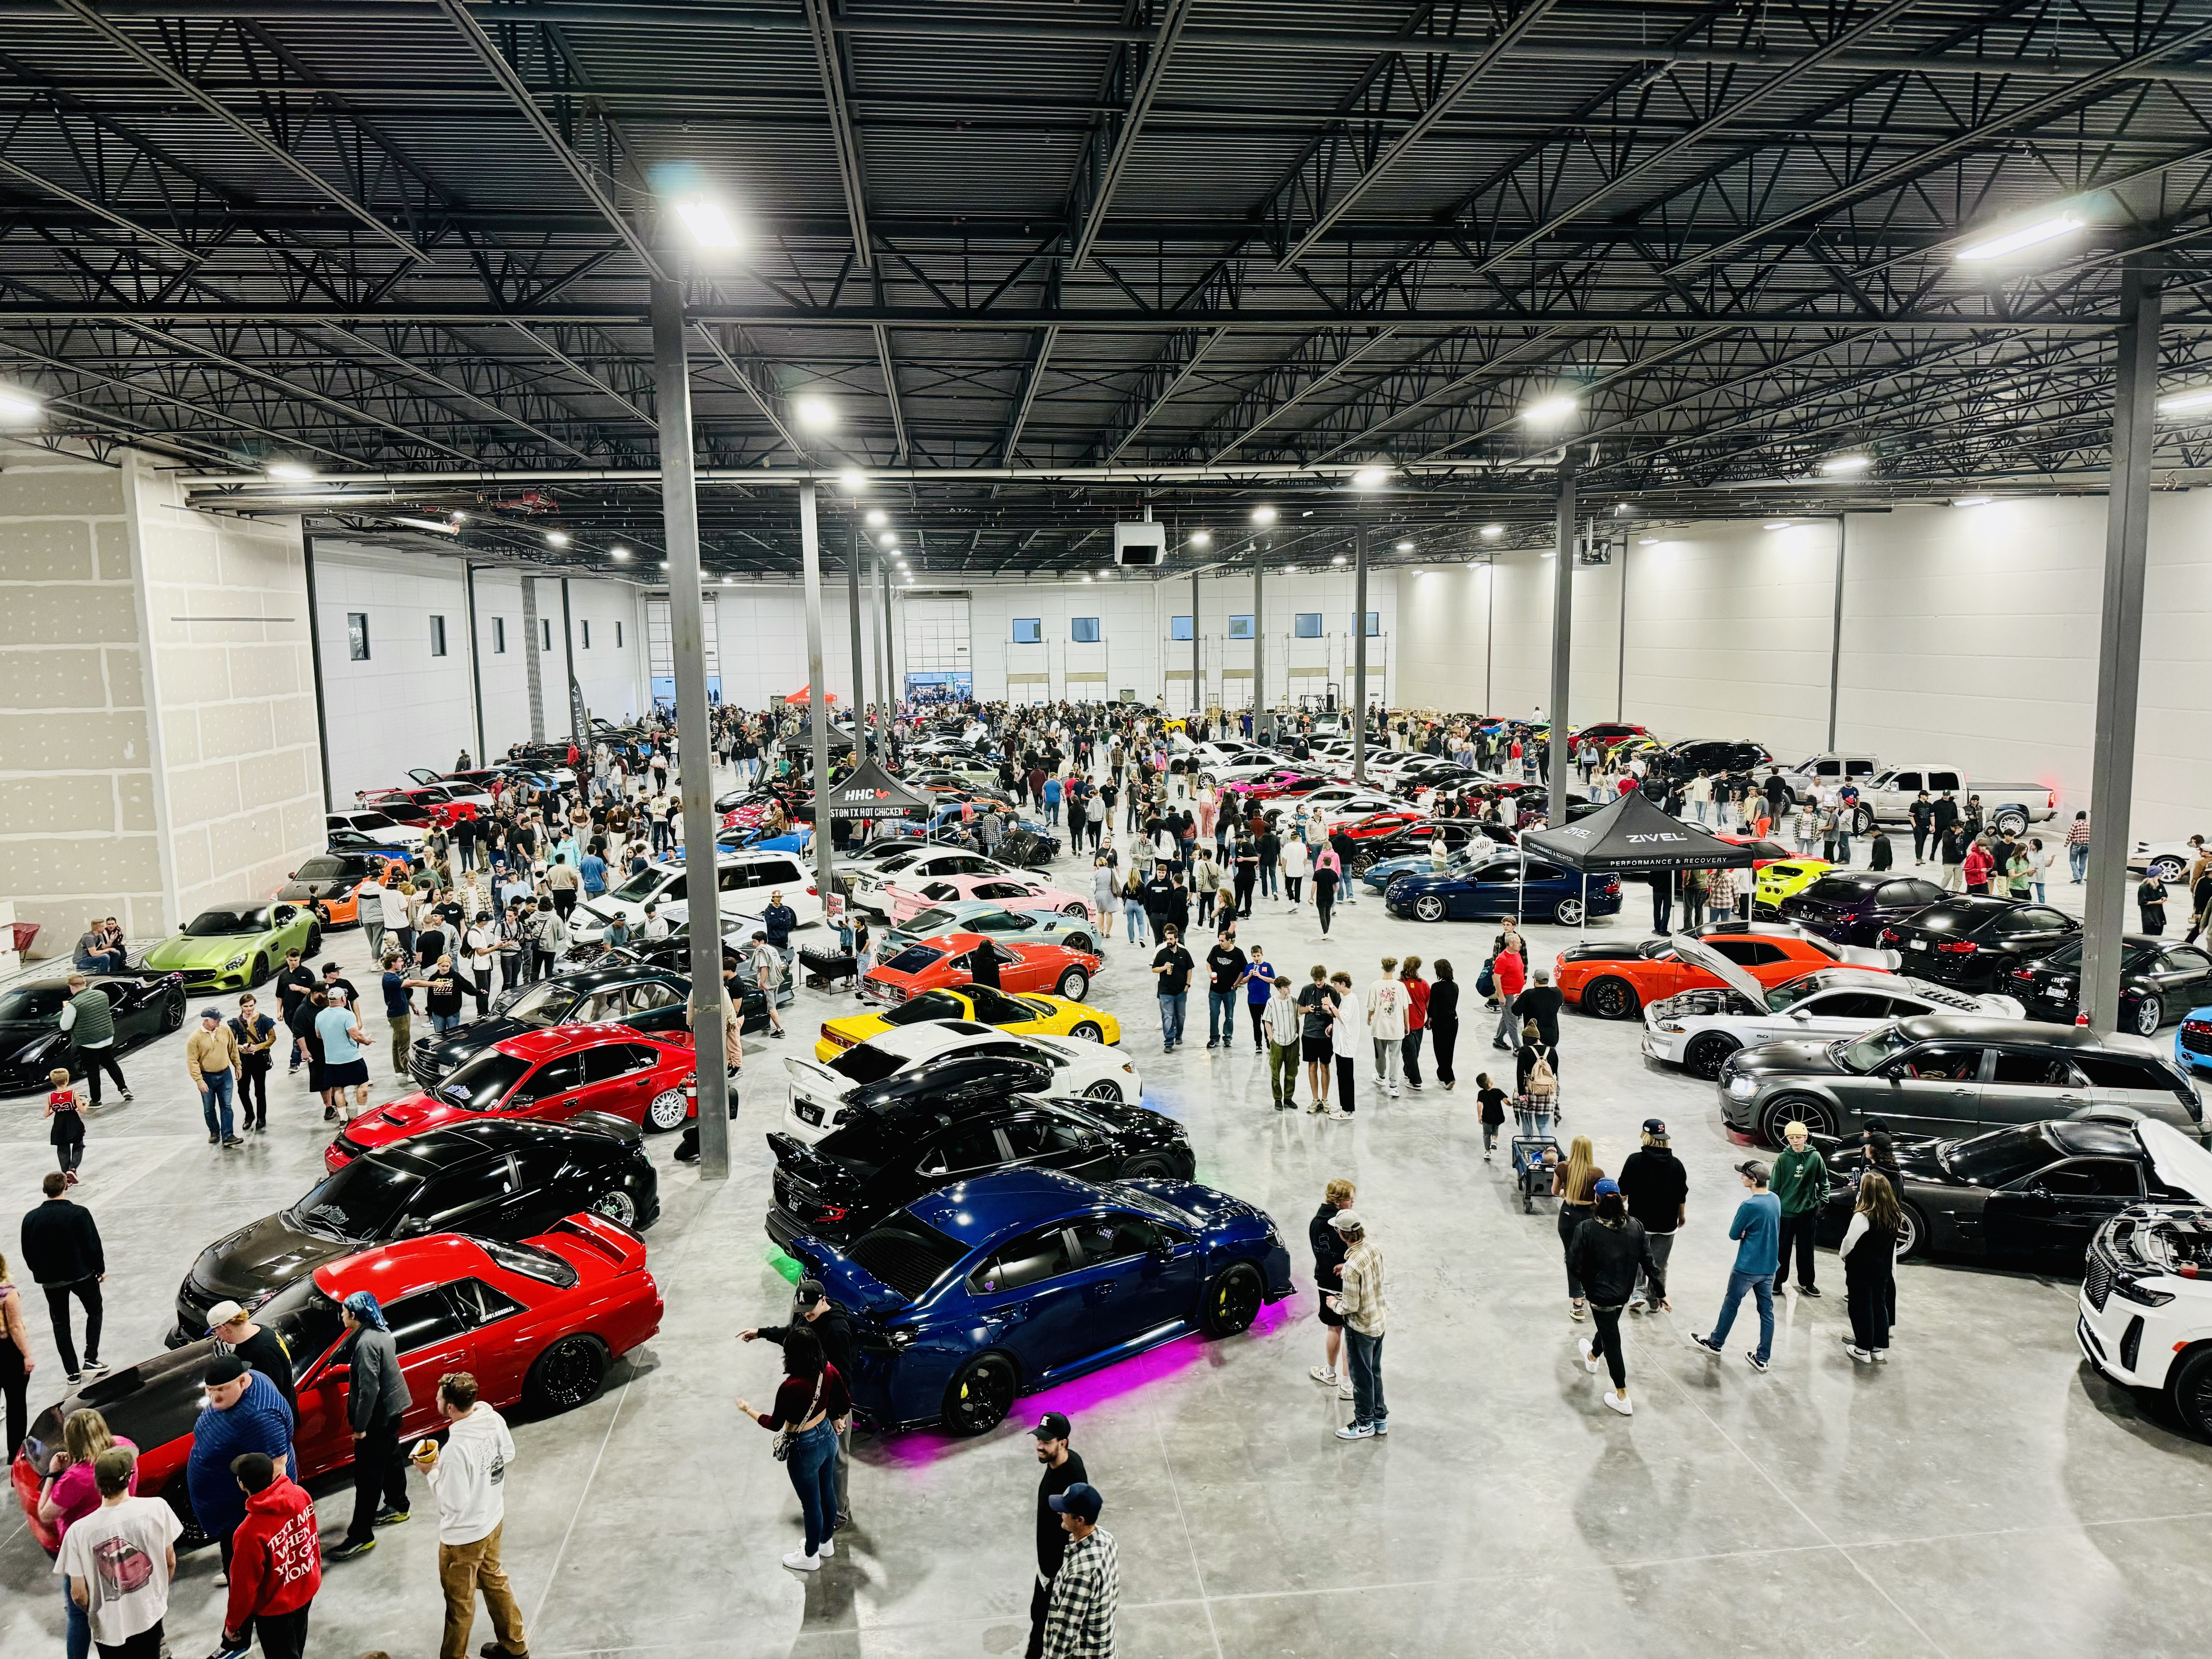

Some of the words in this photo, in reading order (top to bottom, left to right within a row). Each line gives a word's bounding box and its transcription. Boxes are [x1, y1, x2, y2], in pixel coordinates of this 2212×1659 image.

[845, 788, 874, 801] HHC
[830, 808, 849, 817] STON
[850, 808, 859, 817] TX
[860, 807, 874, 817] HOT
[874, 807, 903, 817] CHICKEN
[1626, 833, 1688, 843] ZIVEL
[1530, 842, 1552, 855] PERFORMANCE
[1556, 852, 1573, 863] RECOVERY
[52, 1102, 72, 1112] 23
[267, 1518, 294, 1552] TEXT
[297, 1503, 315, 1527] ME
[275, 1523, 310, 1559] WHEN
